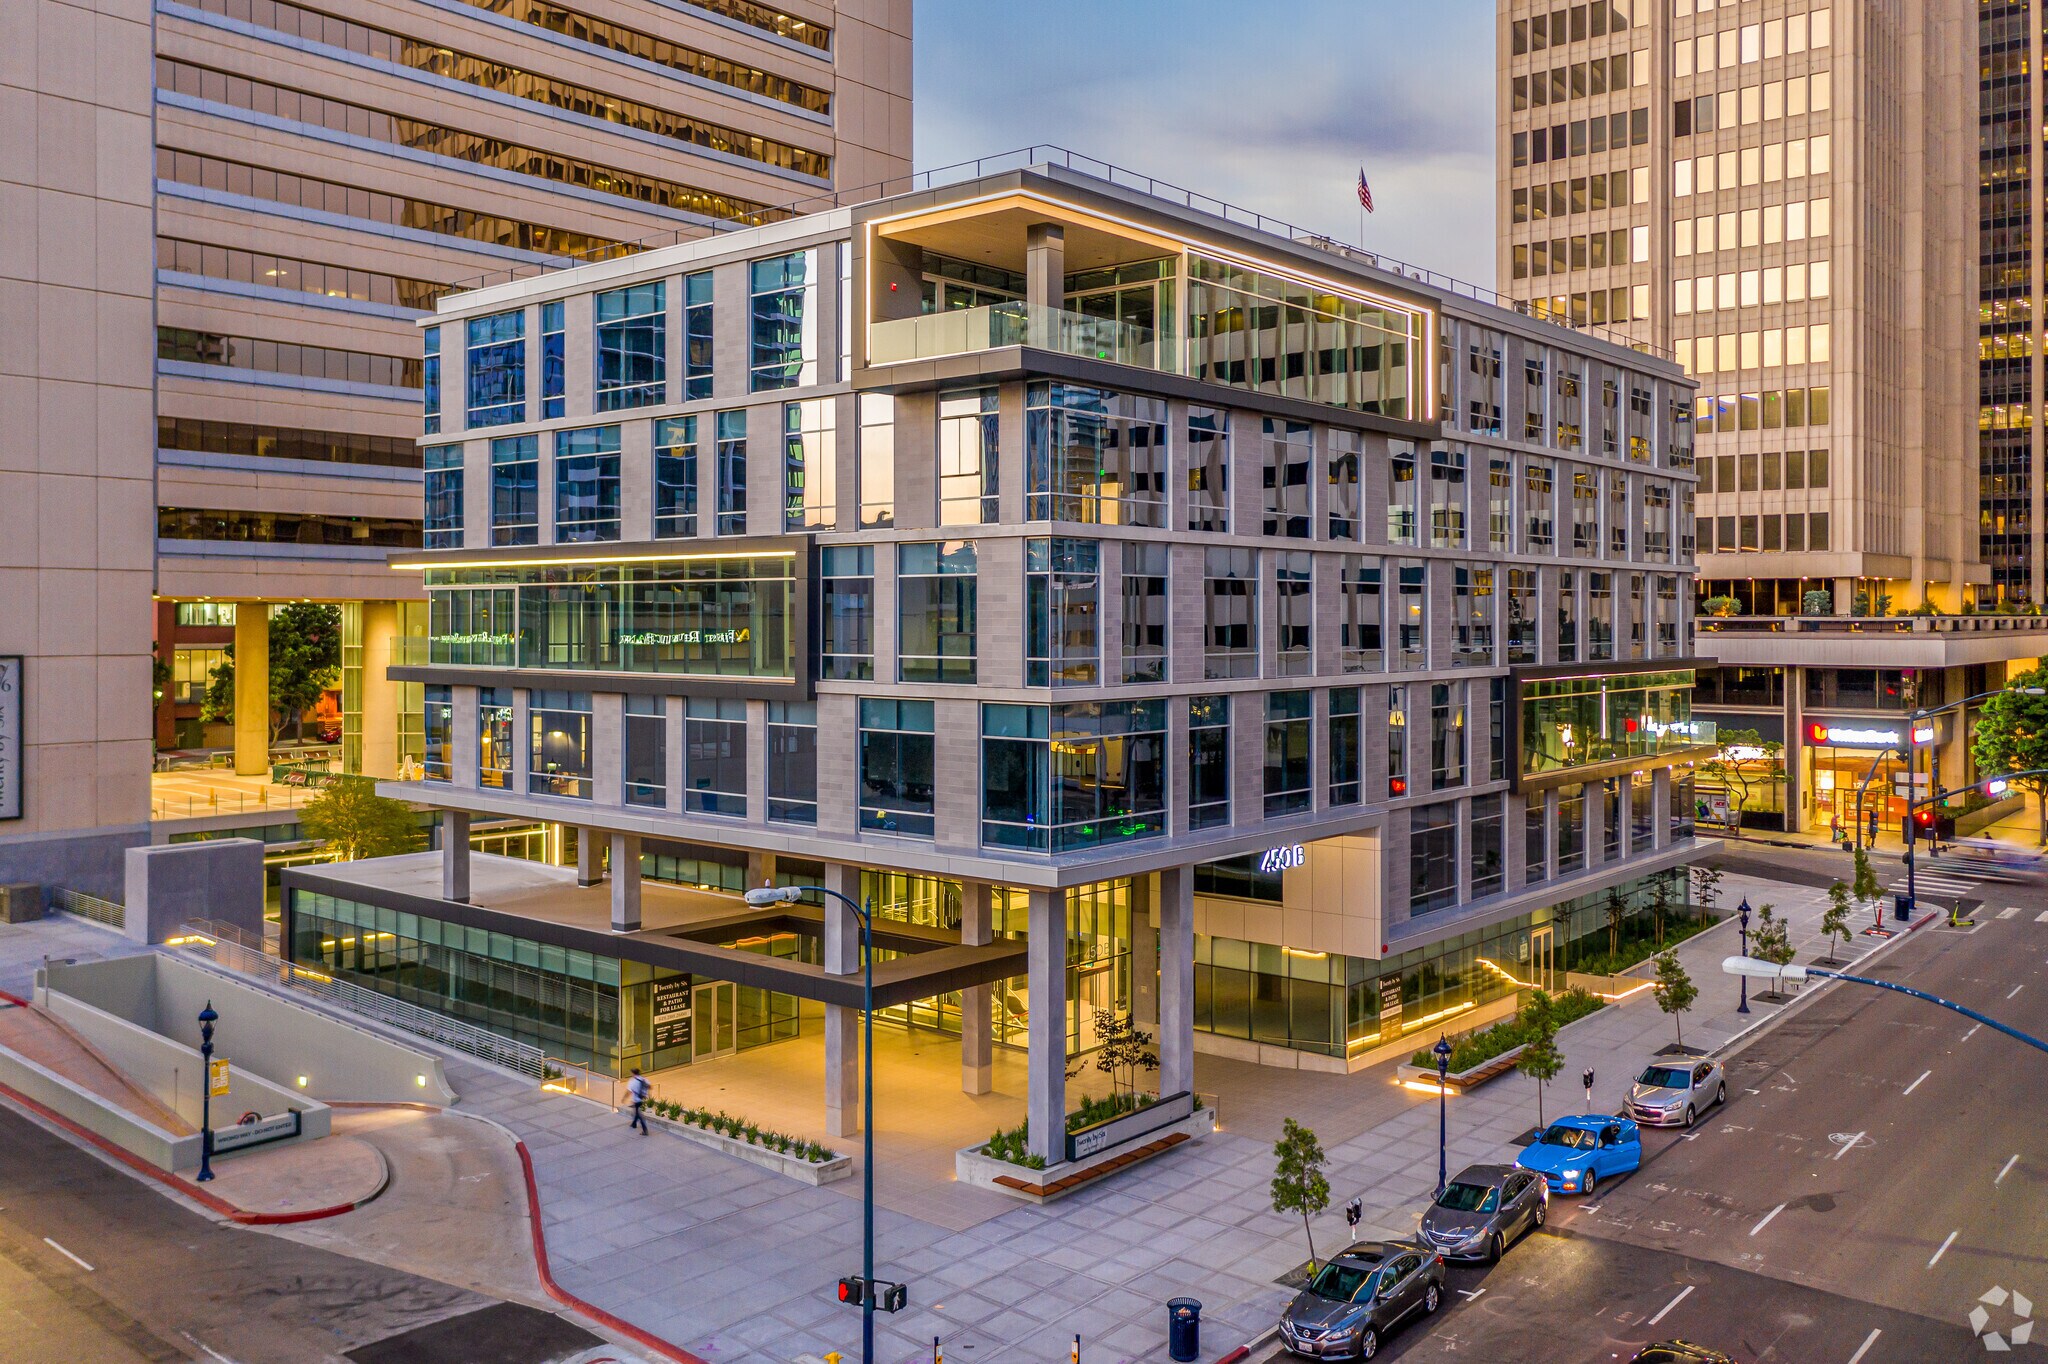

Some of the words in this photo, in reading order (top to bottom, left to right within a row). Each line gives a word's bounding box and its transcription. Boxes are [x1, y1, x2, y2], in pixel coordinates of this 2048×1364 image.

[659, 983, 673, 991] Twenty
[657, 990, 689, 1001] RESTAURANT
[668, 998, 683, 1006] PATIO
[671, 1003, 686, 1011] LEASE
